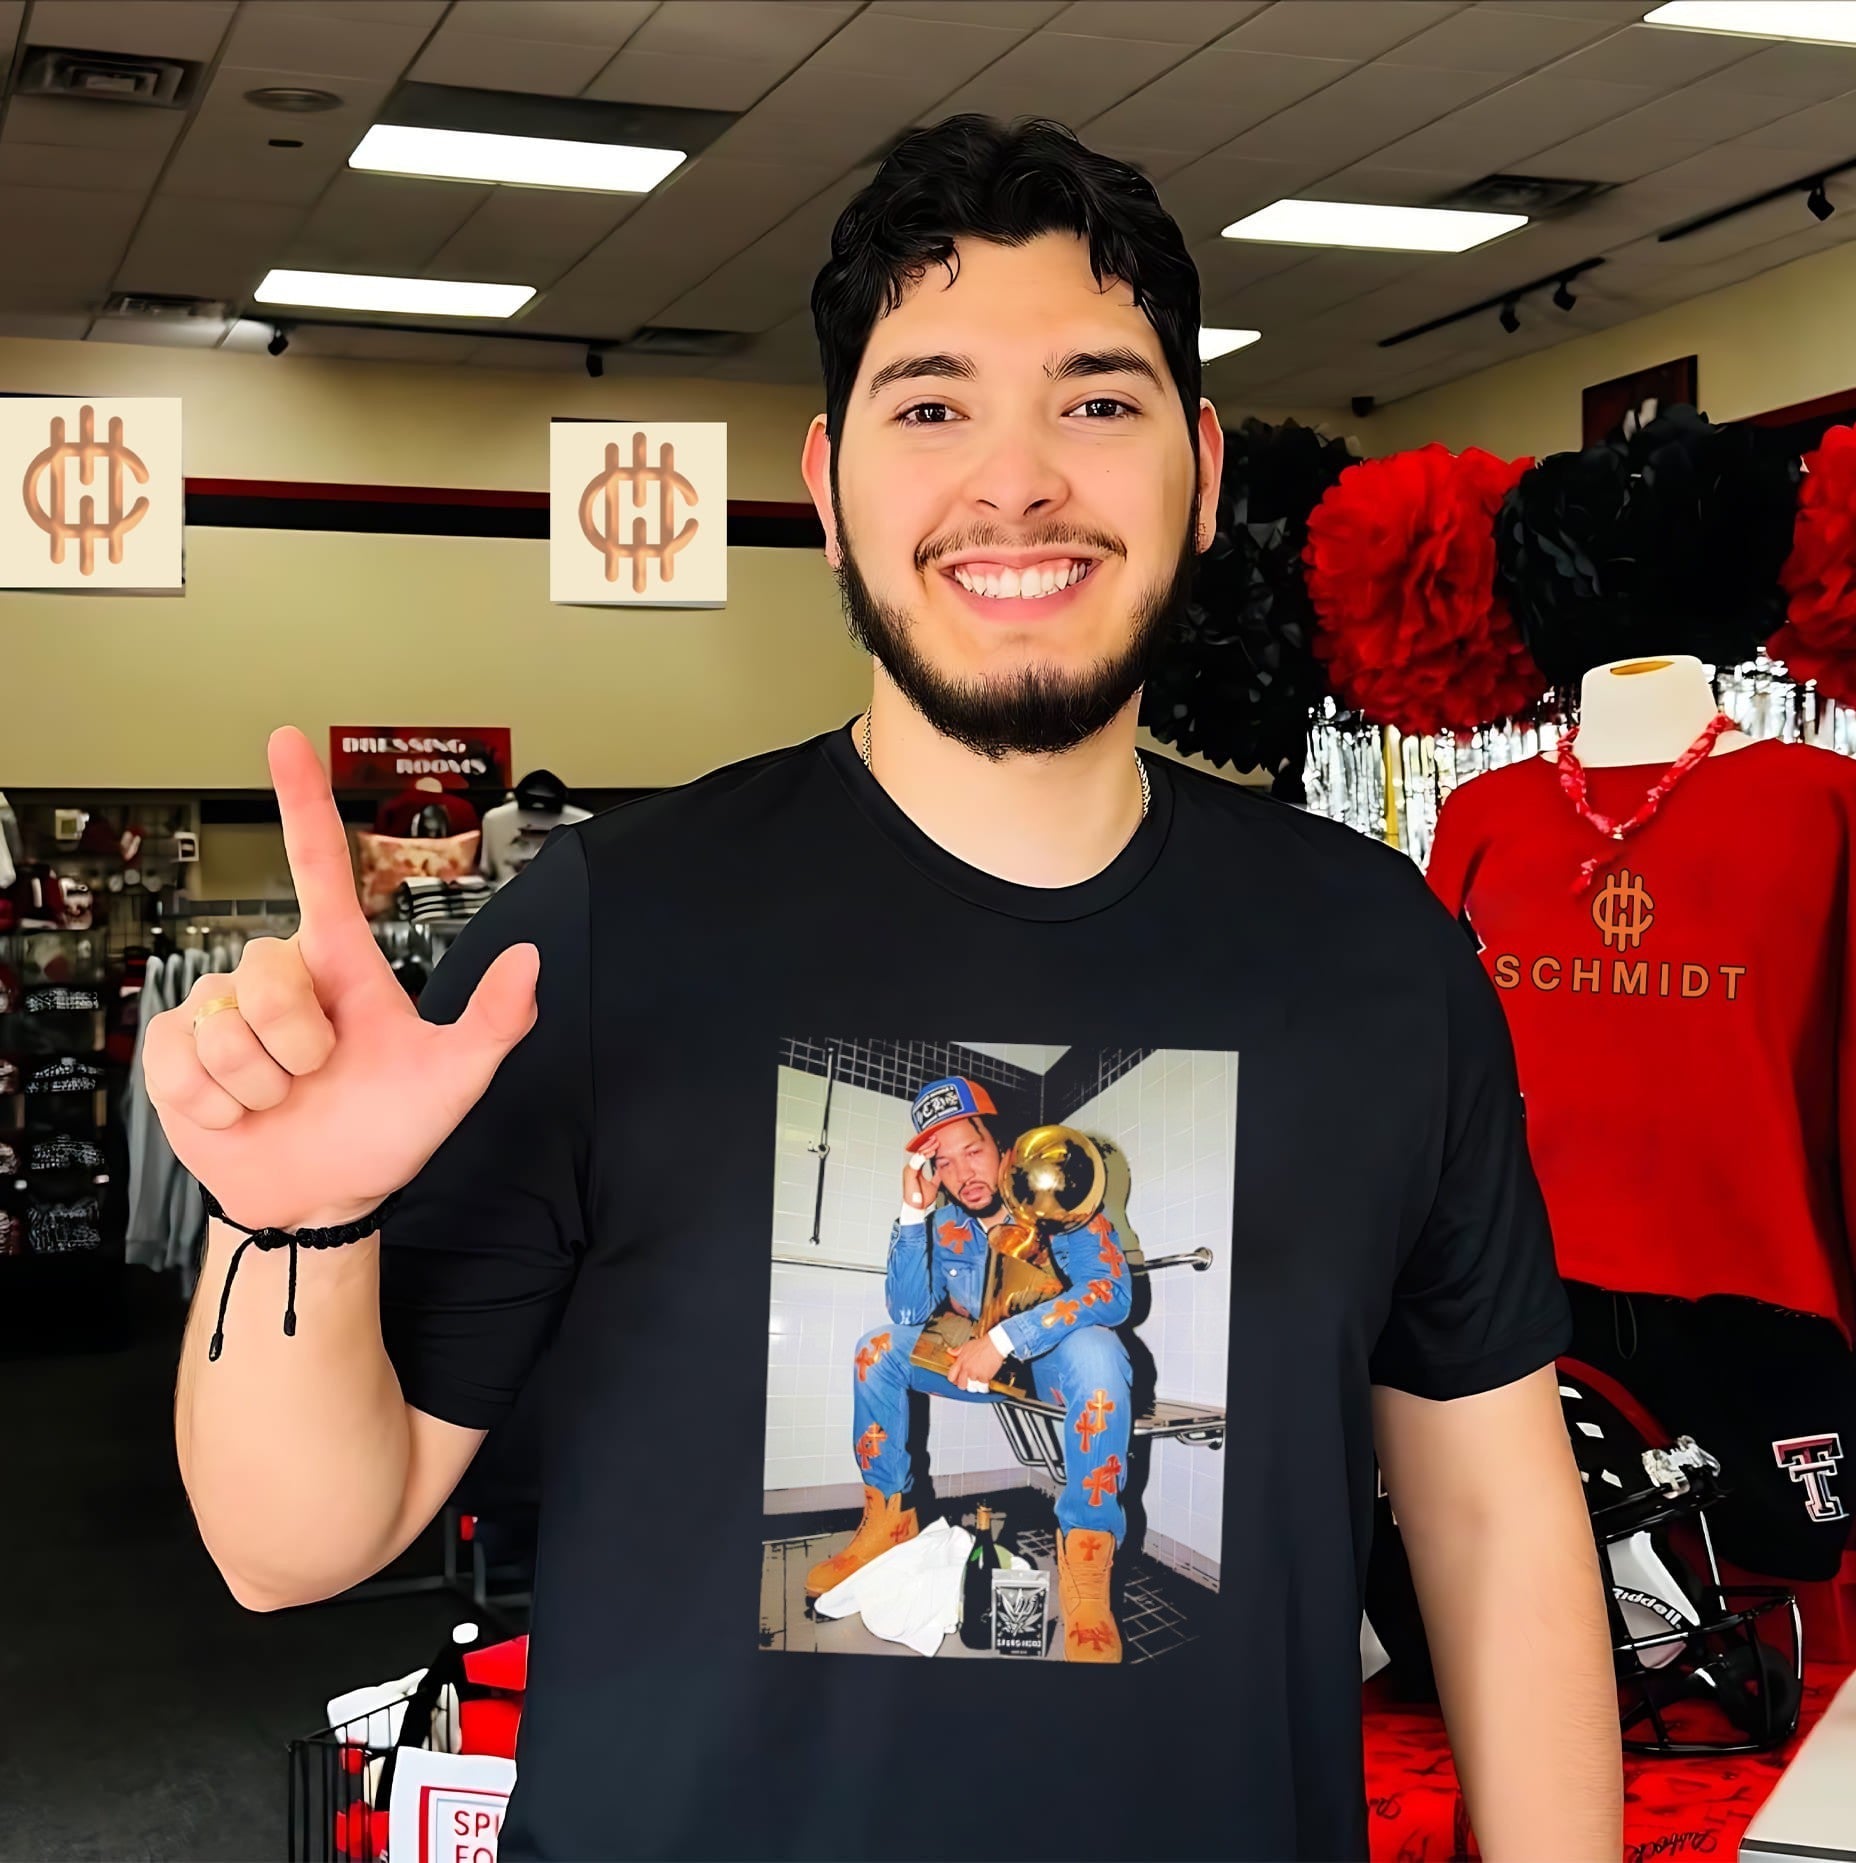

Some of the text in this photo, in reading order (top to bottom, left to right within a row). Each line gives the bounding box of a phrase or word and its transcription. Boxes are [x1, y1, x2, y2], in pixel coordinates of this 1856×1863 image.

[342, 737, 466, 754] DRESSING
[396, 758, 487, 775] ROOMS
[1494, 953, 1746, 1000] SCHMIDT
